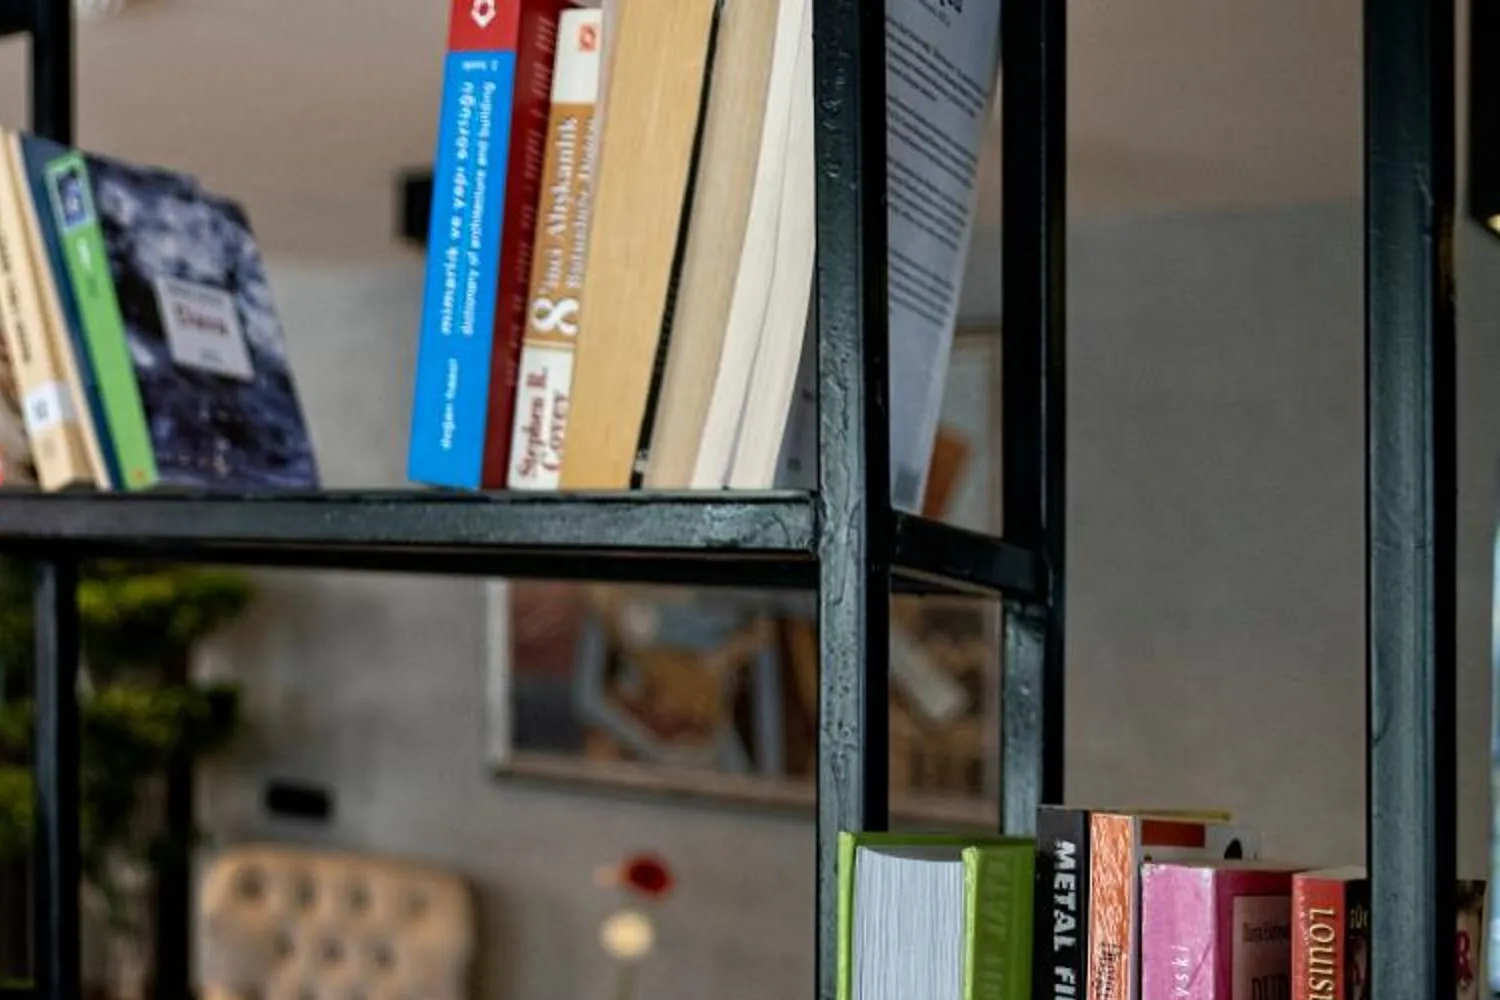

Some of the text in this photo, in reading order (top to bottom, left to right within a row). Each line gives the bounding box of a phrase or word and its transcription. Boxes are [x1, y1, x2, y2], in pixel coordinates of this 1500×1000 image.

[478, 81, 496, 137] building
[477, 140, 490, 167] and
[450, 214, 463, 240] ve
[460, 267, 482, 336] dictionary
[526, 367, 547, 388] R.
[518, 397, 546, 477] Stephen
[542, 389, 568, 471] Covey
[1052, 840, 1077, 952] METAL
